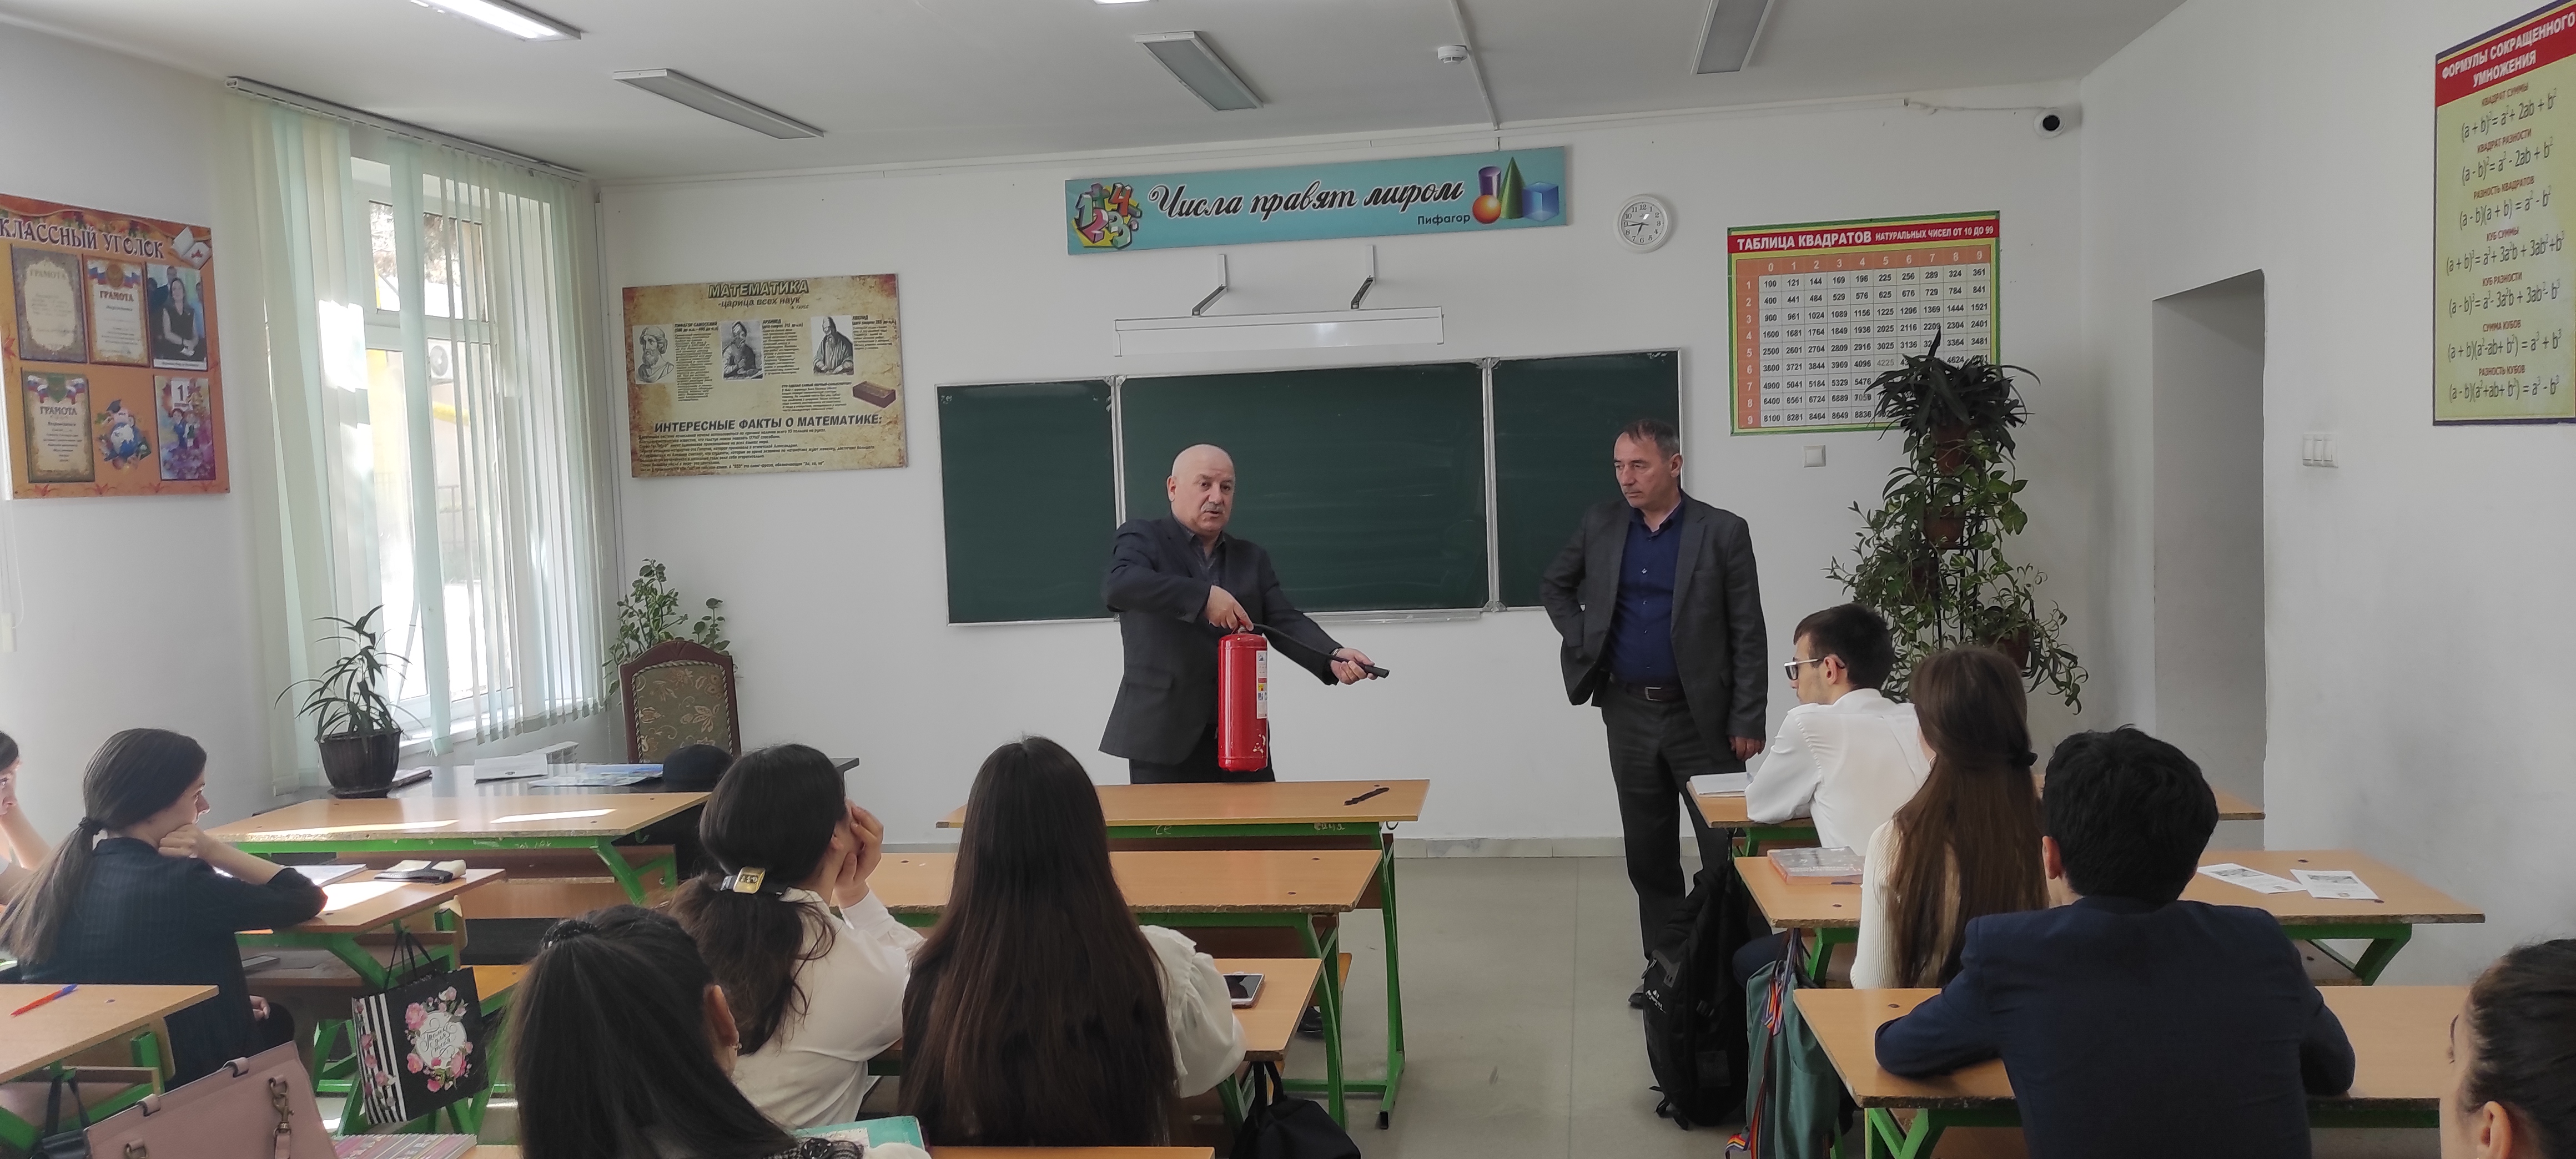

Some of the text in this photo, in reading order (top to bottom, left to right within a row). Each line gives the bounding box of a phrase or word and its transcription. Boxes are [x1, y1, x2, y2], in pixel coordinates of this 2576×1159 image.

[2442, 12, 2576, 80] ФОРМУЛЫ СОКРАЩЕННОГО
[2473, 49, 2537, 88] УМНОЖЕНИЯ
[2473, 175, 2535, 200] РАЗНОСТЬ КВАДРАТОВ
[1149, 180, 1464, 221] Числа правят миром
[1417, 214, 1471, 225] Пифагор
[0, 218, 165, 259] КЛАССНЫЙ УГОЛОК
[1737, 225, 1994, 250] ТАБЛИЦА КВАДРАТОВ НАТУРАЛЬНЫХ ЧИСЕЛ ОТ 10 ДО 99
[2486, 226, 2520, 242] КУБ СУММЫ
[1768, 250, 1983, 272] 0 1 2 3 4 5 6 7 8 9
[1747, 281, 1751, 290] 1
[1764, 280, 1777, 288] 100
[1787, 279, 1799, 287] 121
[1809, 277, 1823, 285] 144
[1878, 274, 1892, 282] 225
[1948, 269, 1962, 278] 324
[2482, 271, 2522, 286] КУБ РАЗНОСТИ
[99, 290, 134, 302] ГРАМОТА
[708, 280, 809, 299] МАТЕМАТИКА
[1745, 298, 1752, 307] 2
[1764, 296, 1777, 305] 400
[1787, 295, 1799, 304] 441
[1833, 293, 1845, 301] 529
[1855, 291, 1869, 300] 576
[1878, 290, 1892, 299] 625
[1901, 289, 1915, 298] 676
[1925, 288, 1939, 296] 729
[1949, 286, 1962, 295] 784
[1973, 285, 1985, 294] 841
[779, 297, 801, 305] наук
[1746, 303, 1988, 324] 3 900 961 1024 1089 1156 1225 1296 1369 1444 1521
[1746, 331, 1752, 340] 4
[1763, 330, 1779, 339] 1600
[1808, 328, 1825, 336] 1764
[1831, 327, 1848, 335] 1849
[1854, 326, 1871, 334] 1936
[1876, 325, 1894, 333] 2025
[1900, 323, 1918, 332] 2116
[1946, 321, 1964, 329] 2304
[1970, 320, 1988, 328] 2401
[2483, 319, 2522, 332] СУММА КУБОВ
[1747, 348, 1753, 357] 5
[1747, 365, 1753, 374] 6
[2479, 364, 2526, 376] РАЗНОСТЬ КУБОВ
[1747, 382, 1753, 391] 7
[40, 406, 77, 416] ГРАМОТА
[1747, 399, 1753, 408] 8
[655, 414, 883, 432] ИНТЕРЕСНЫЕ ФАКТЫ О МАТЕМАТИКЕ:
[1747, 416, 1753, 425] 9
